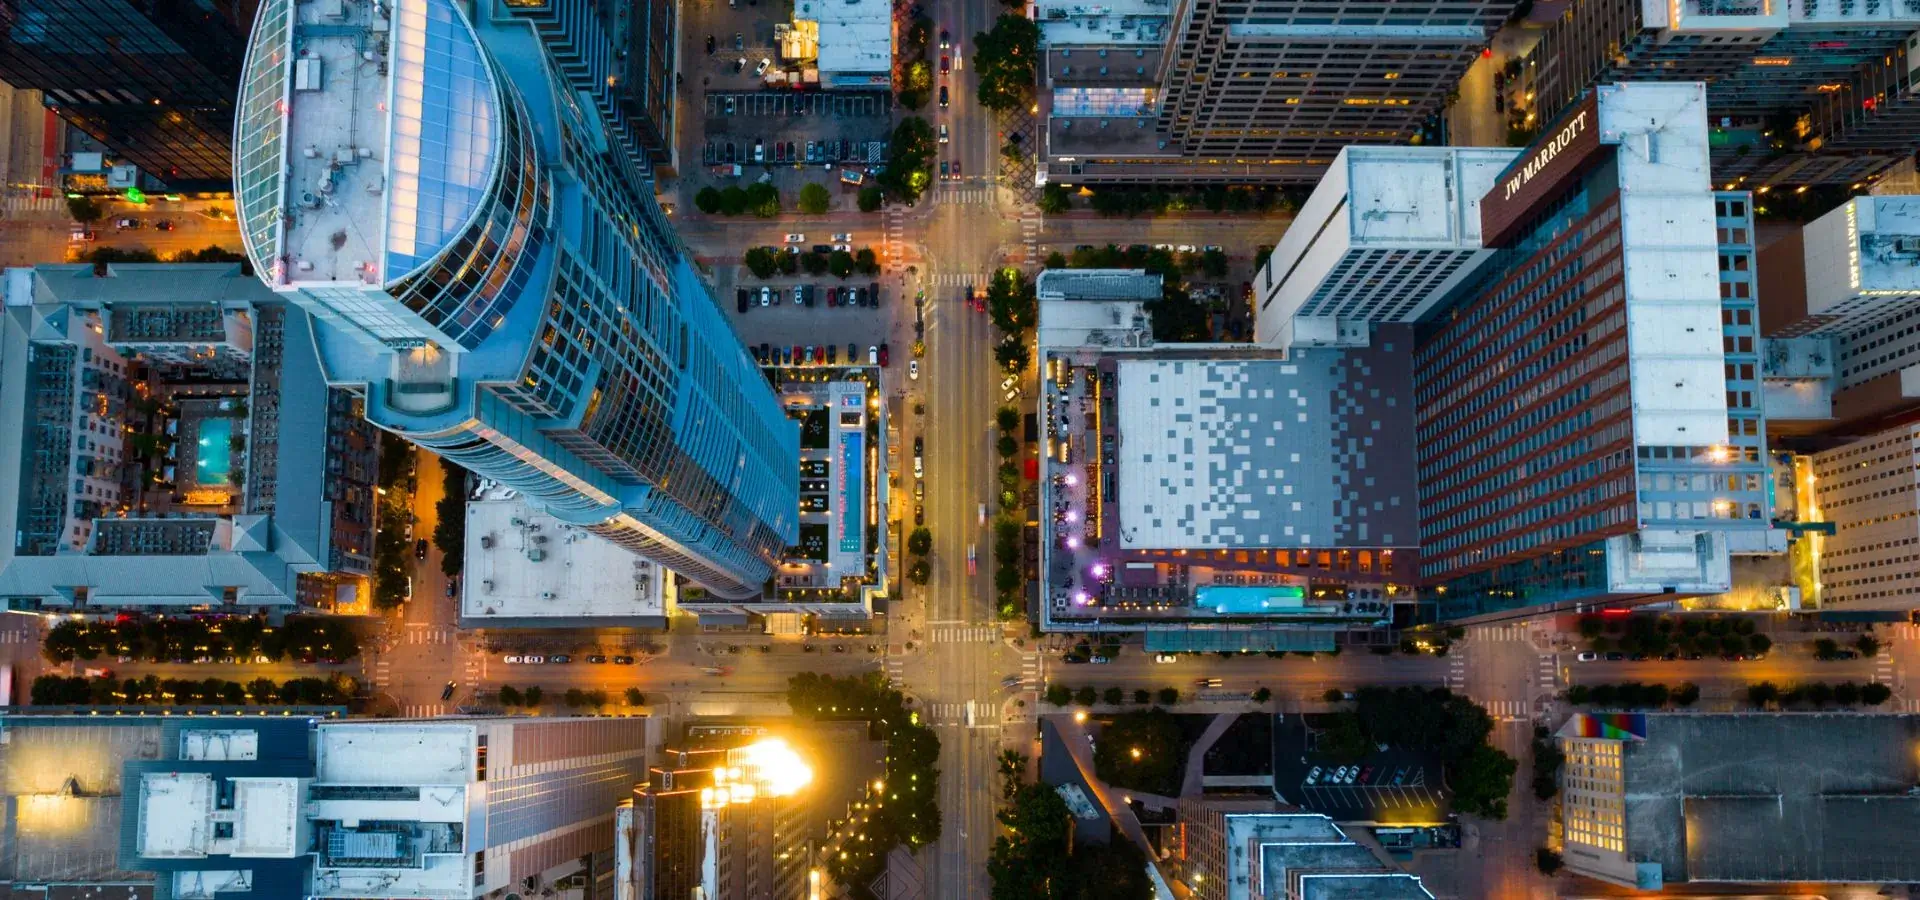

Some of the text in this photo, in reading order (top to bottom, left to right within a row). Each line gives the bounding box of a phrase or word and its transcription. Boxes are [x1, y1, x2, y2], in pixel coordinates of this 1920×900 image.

[1505, 111, 1586, 201] JW MARRIOTT
[1847, 213, 1859, 289] HYATT PLACE
